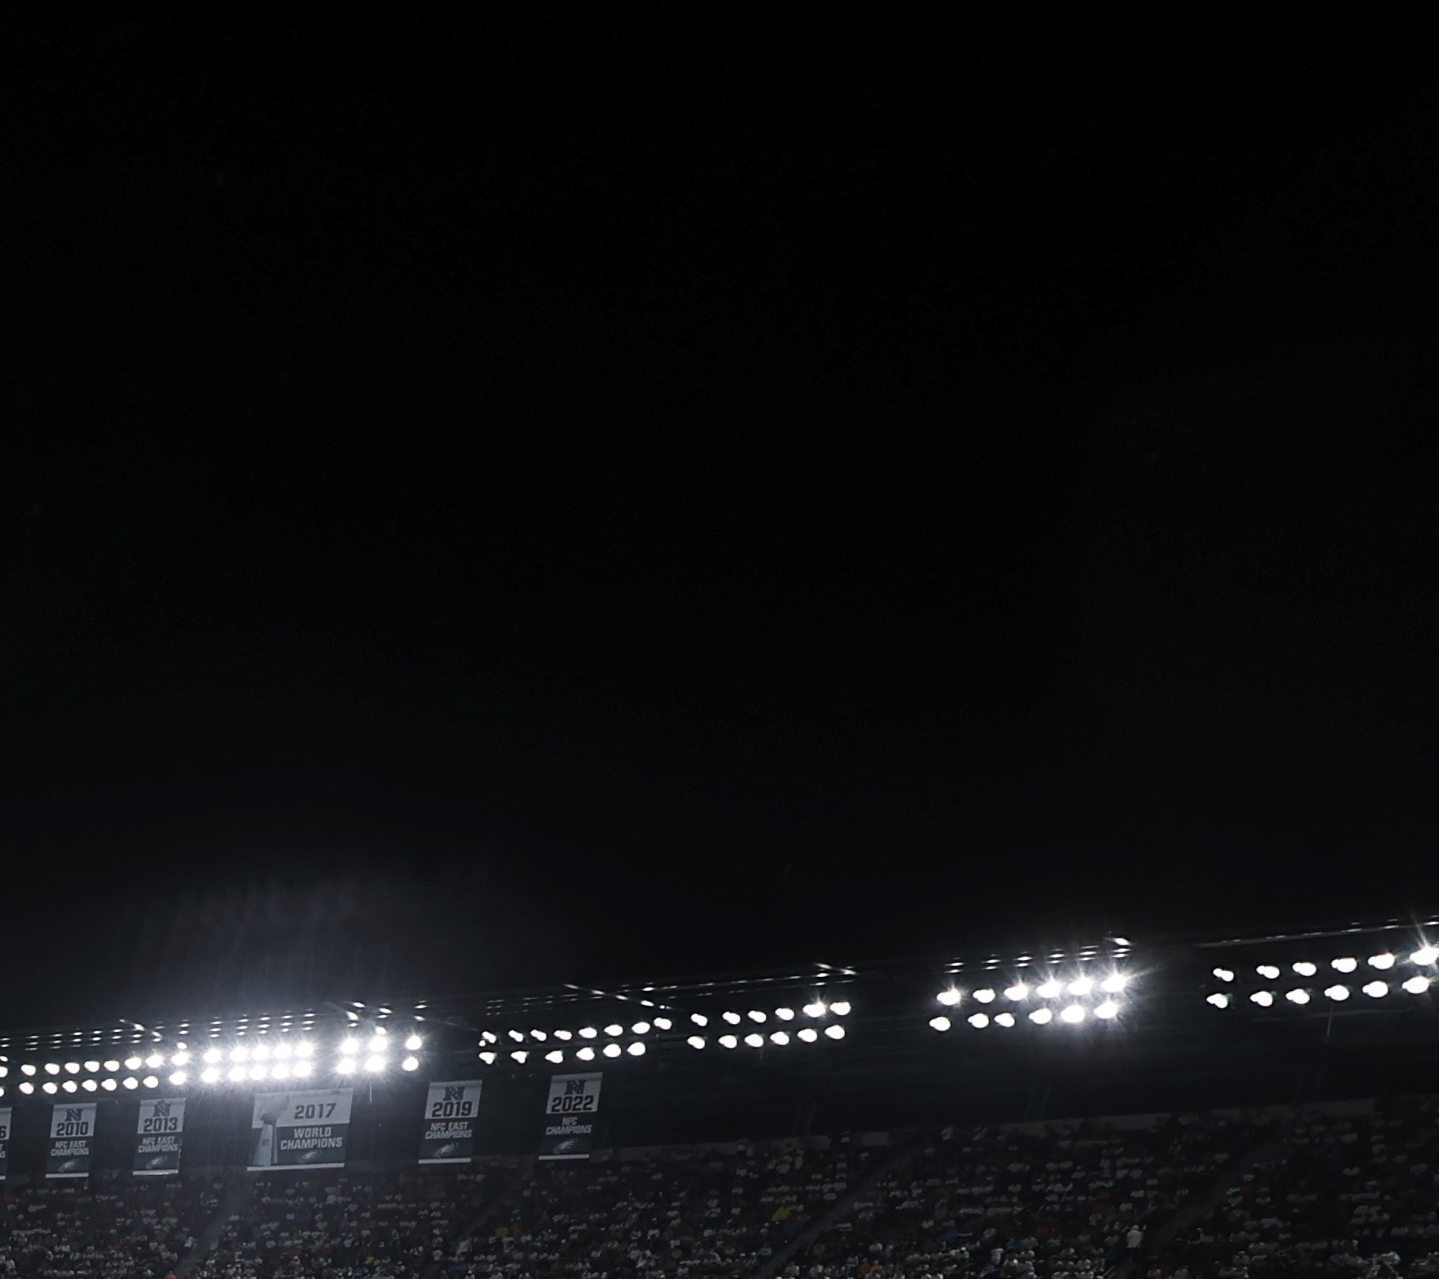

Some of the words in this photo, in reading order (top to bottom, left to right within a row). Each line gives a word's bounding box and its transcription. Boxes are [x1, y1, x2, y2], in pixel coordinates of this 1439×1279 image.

[294, 1103, 337, 1119] 2017
[432, 1101, 472, 1118] 2019
[551, 1095, 594, 1112] 2022
[56, 1122, 89, 1136] 2010
[143, 1117, 179, 1132] 2013
[293, 1127, 332, 1139] WORLD
[280, 1136, 343, 1150] CHAMPIONS
